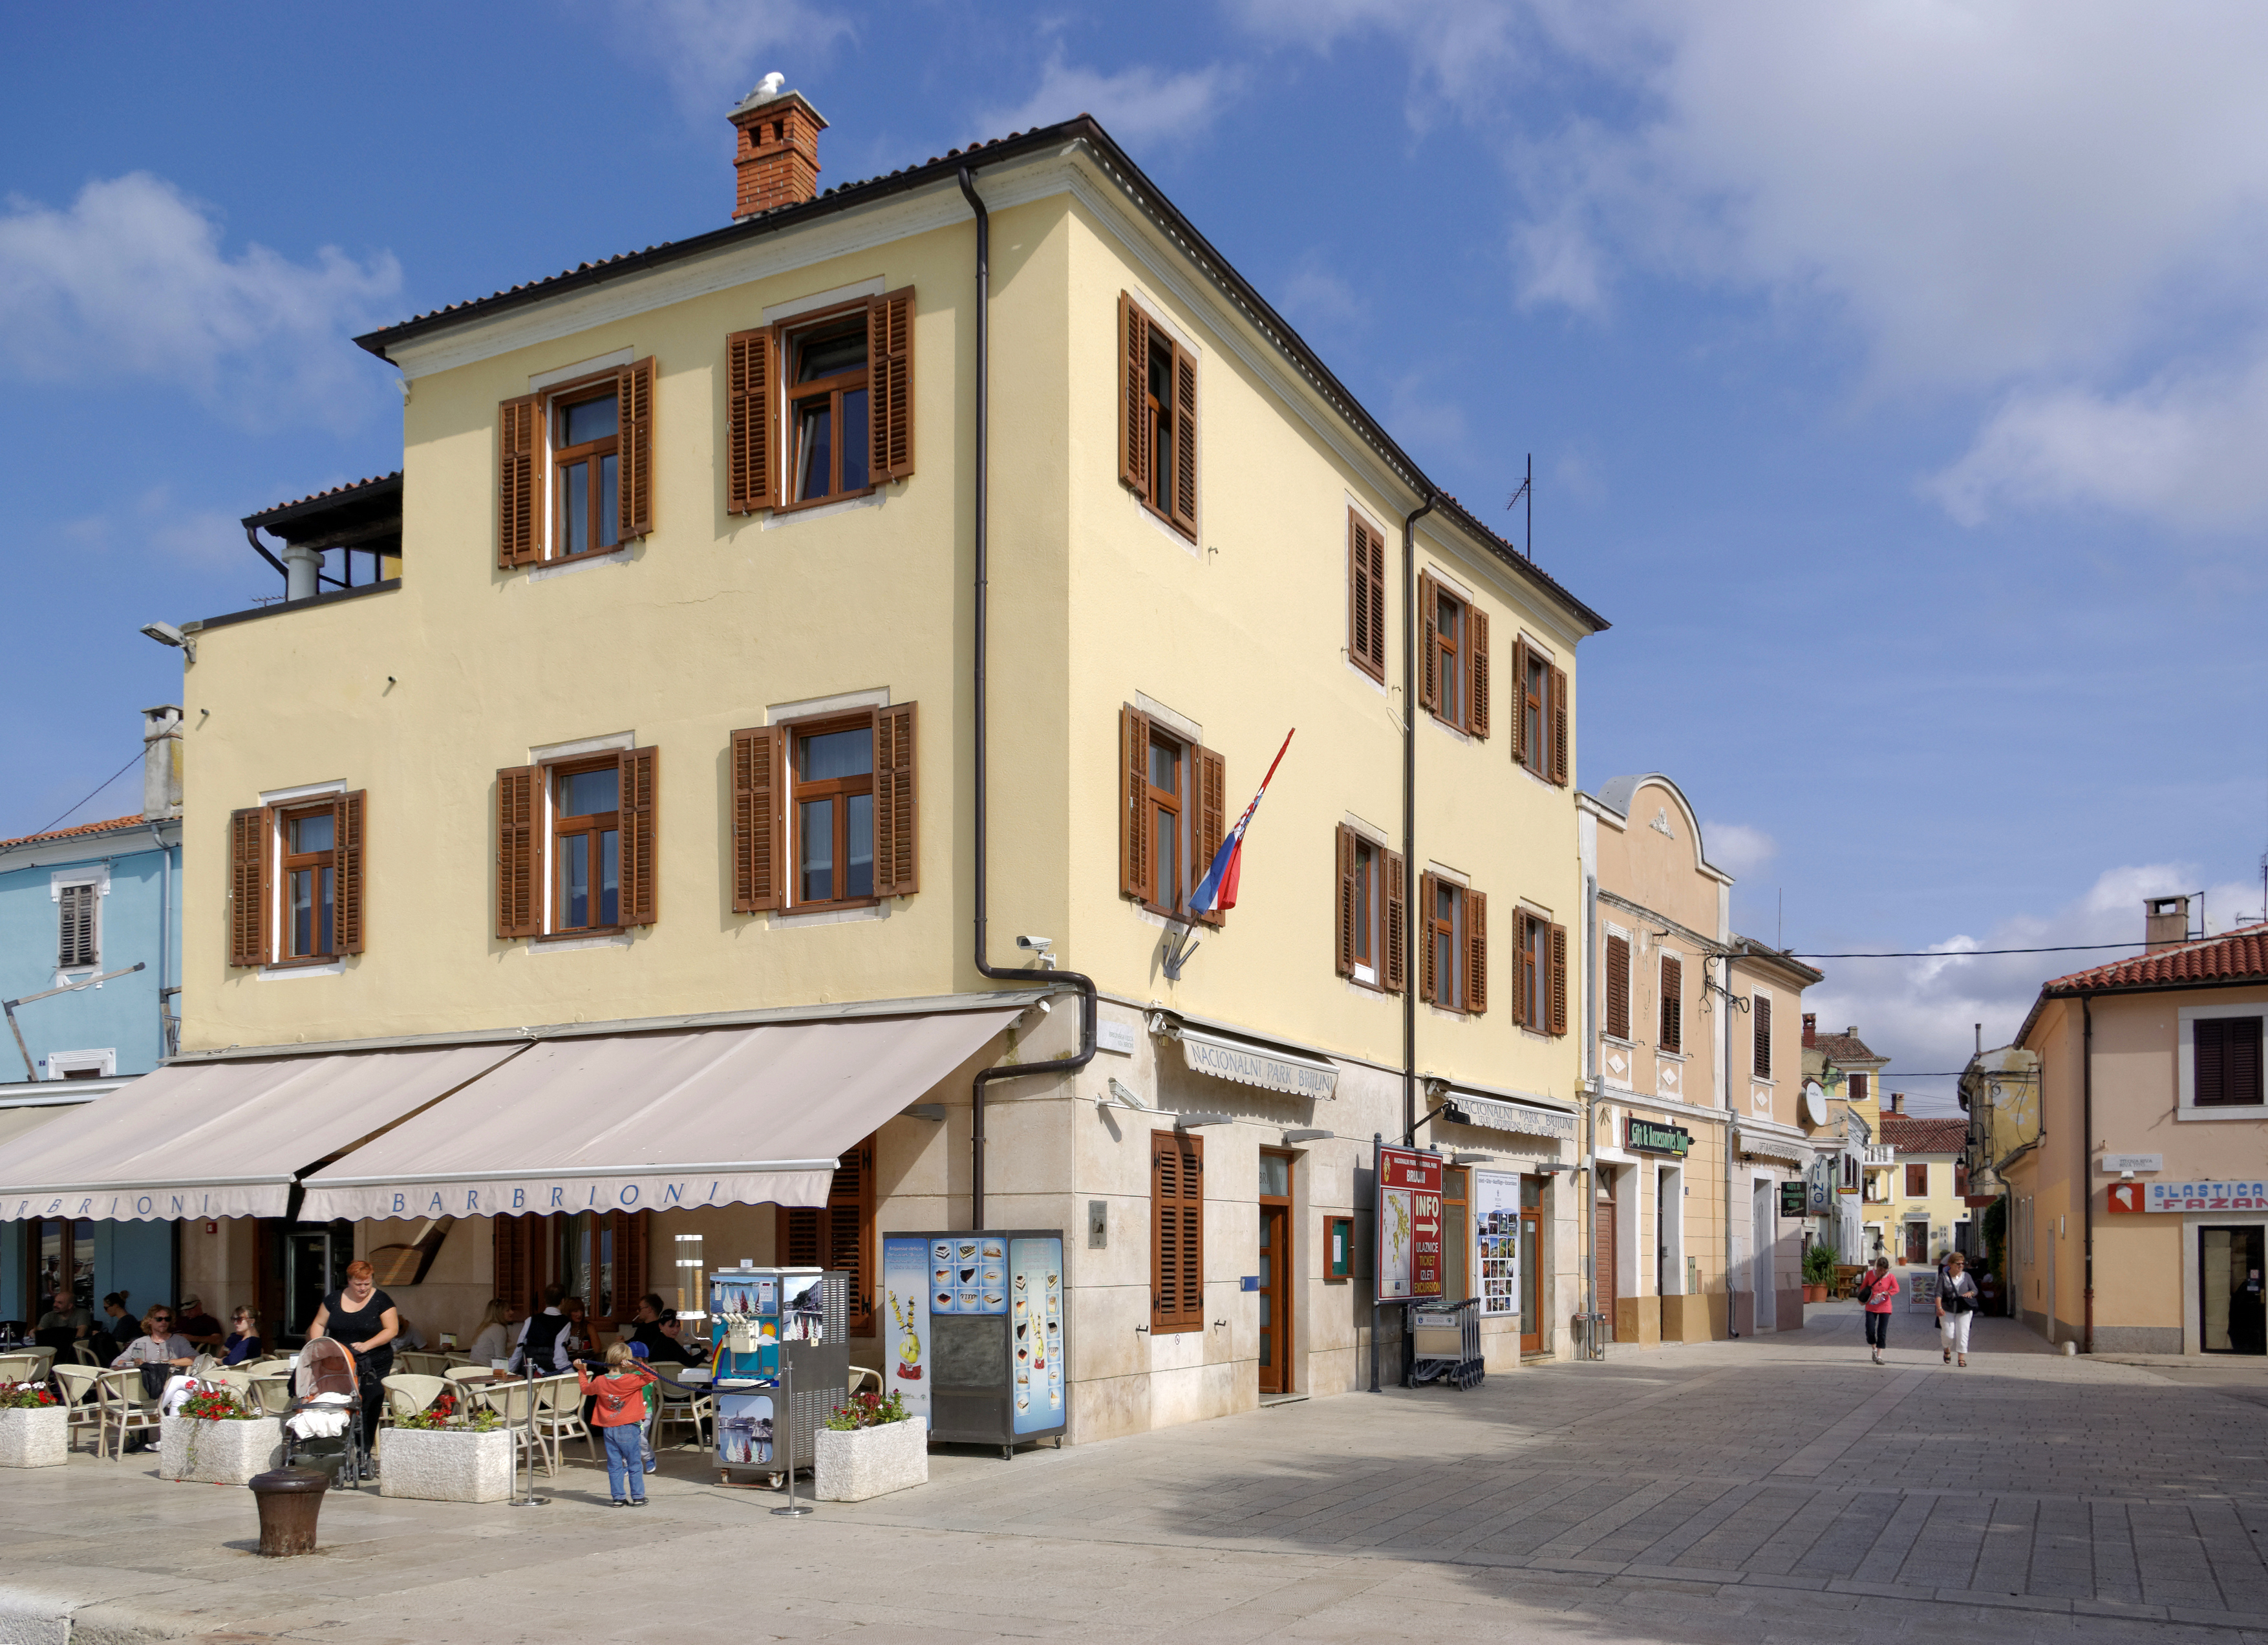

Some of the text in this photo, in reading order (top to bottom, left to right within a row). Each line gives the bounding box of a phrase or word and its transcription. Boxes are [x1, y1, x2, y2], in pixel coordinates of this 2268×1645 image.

[1191, 1044, 1332, 1093] NACIONALNI PARK BRIJUNI
[1457, 1099, 1572, 1130] NACIONALNI PARK BRIJUNI
[1632, 1123, 1643, 1147] Gift
[1643, 1125, 1648, 1146] &
[1676, 1130, 1688, 1154] Shop
[1407, 1169, 1426, 1183] BRIJUNI
[1813, 1159, 1823, 1203] VINO
[46, 1194, 208, 1214] BRIONI
[392, 1181, 718, 1212] BAR BRIONI
[1416, 1196, 1439, 1218] INFO
[1416, 1242, 1439, 1253] ULAZNICE
[1419, 1256, 1435, 1266] TICKET
[1420, 1270, 1434, 1280] IZLETI
[1415, 1282, 1440, 1293] EXCURSION
